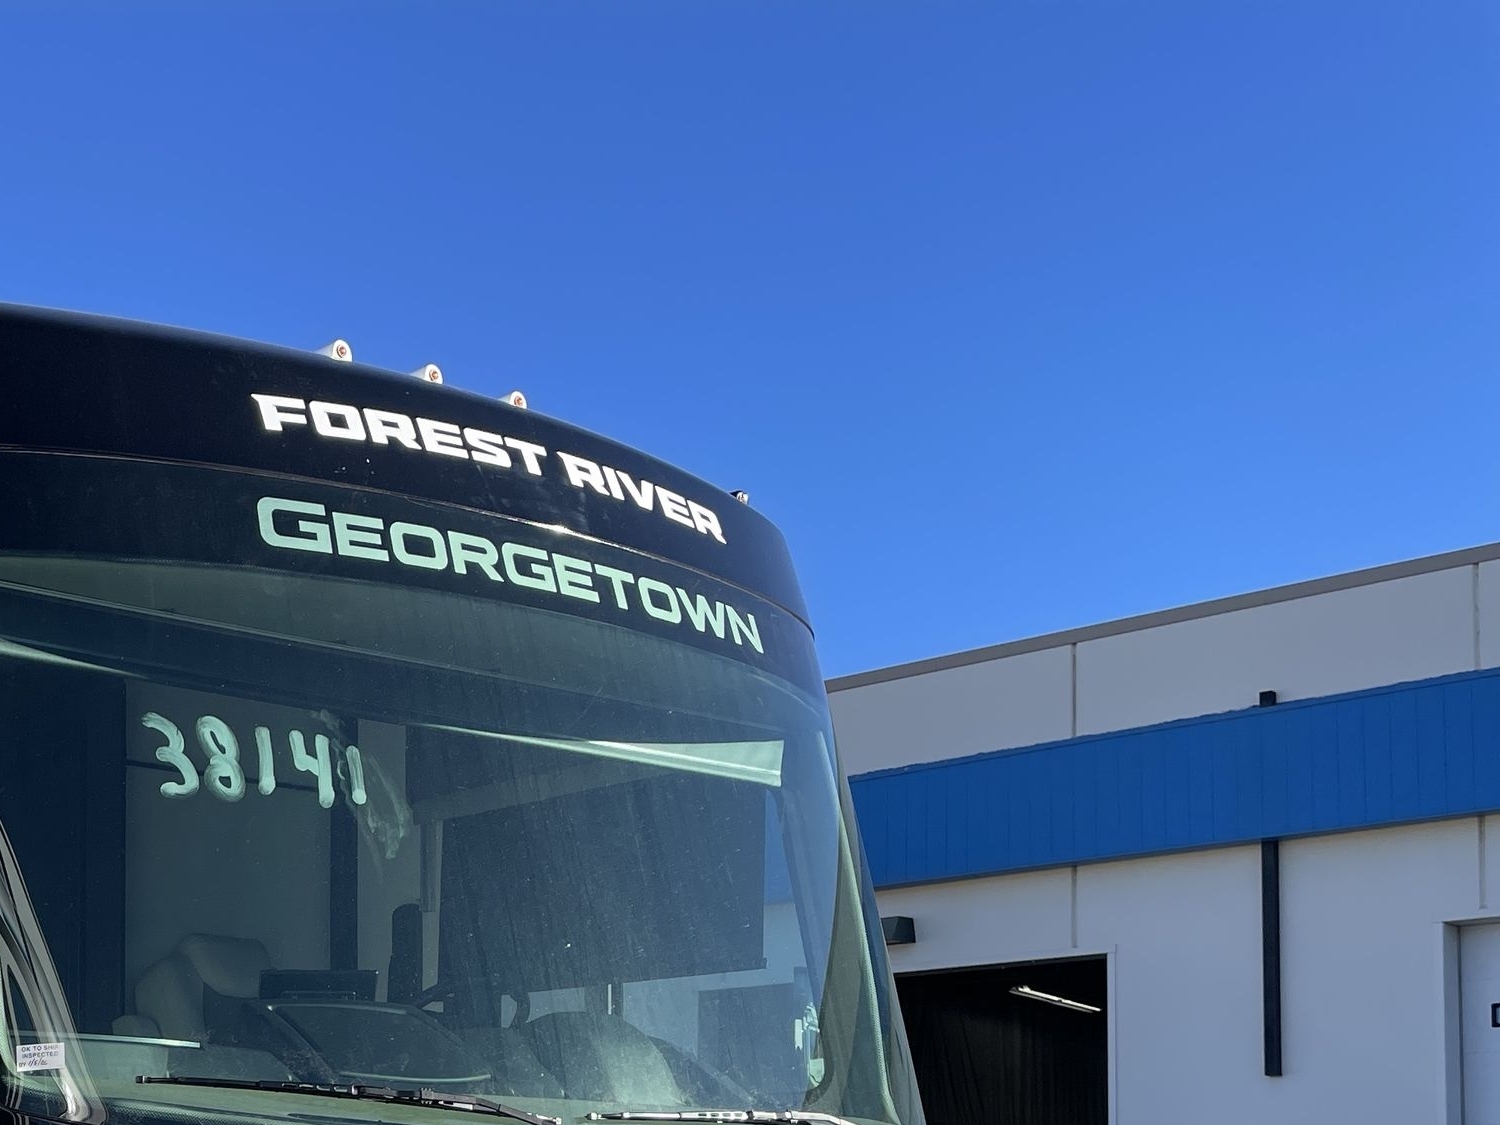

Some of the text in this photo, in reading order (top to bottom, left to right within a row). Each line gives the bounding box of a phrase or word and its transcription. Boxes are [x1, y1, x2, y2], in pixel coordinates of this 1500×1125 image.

[251, 393, 726, 543] FOREST RIVER
[257, 496, 764, 654] GEORGETOWN
[141, 712, 367, 808] 38141
